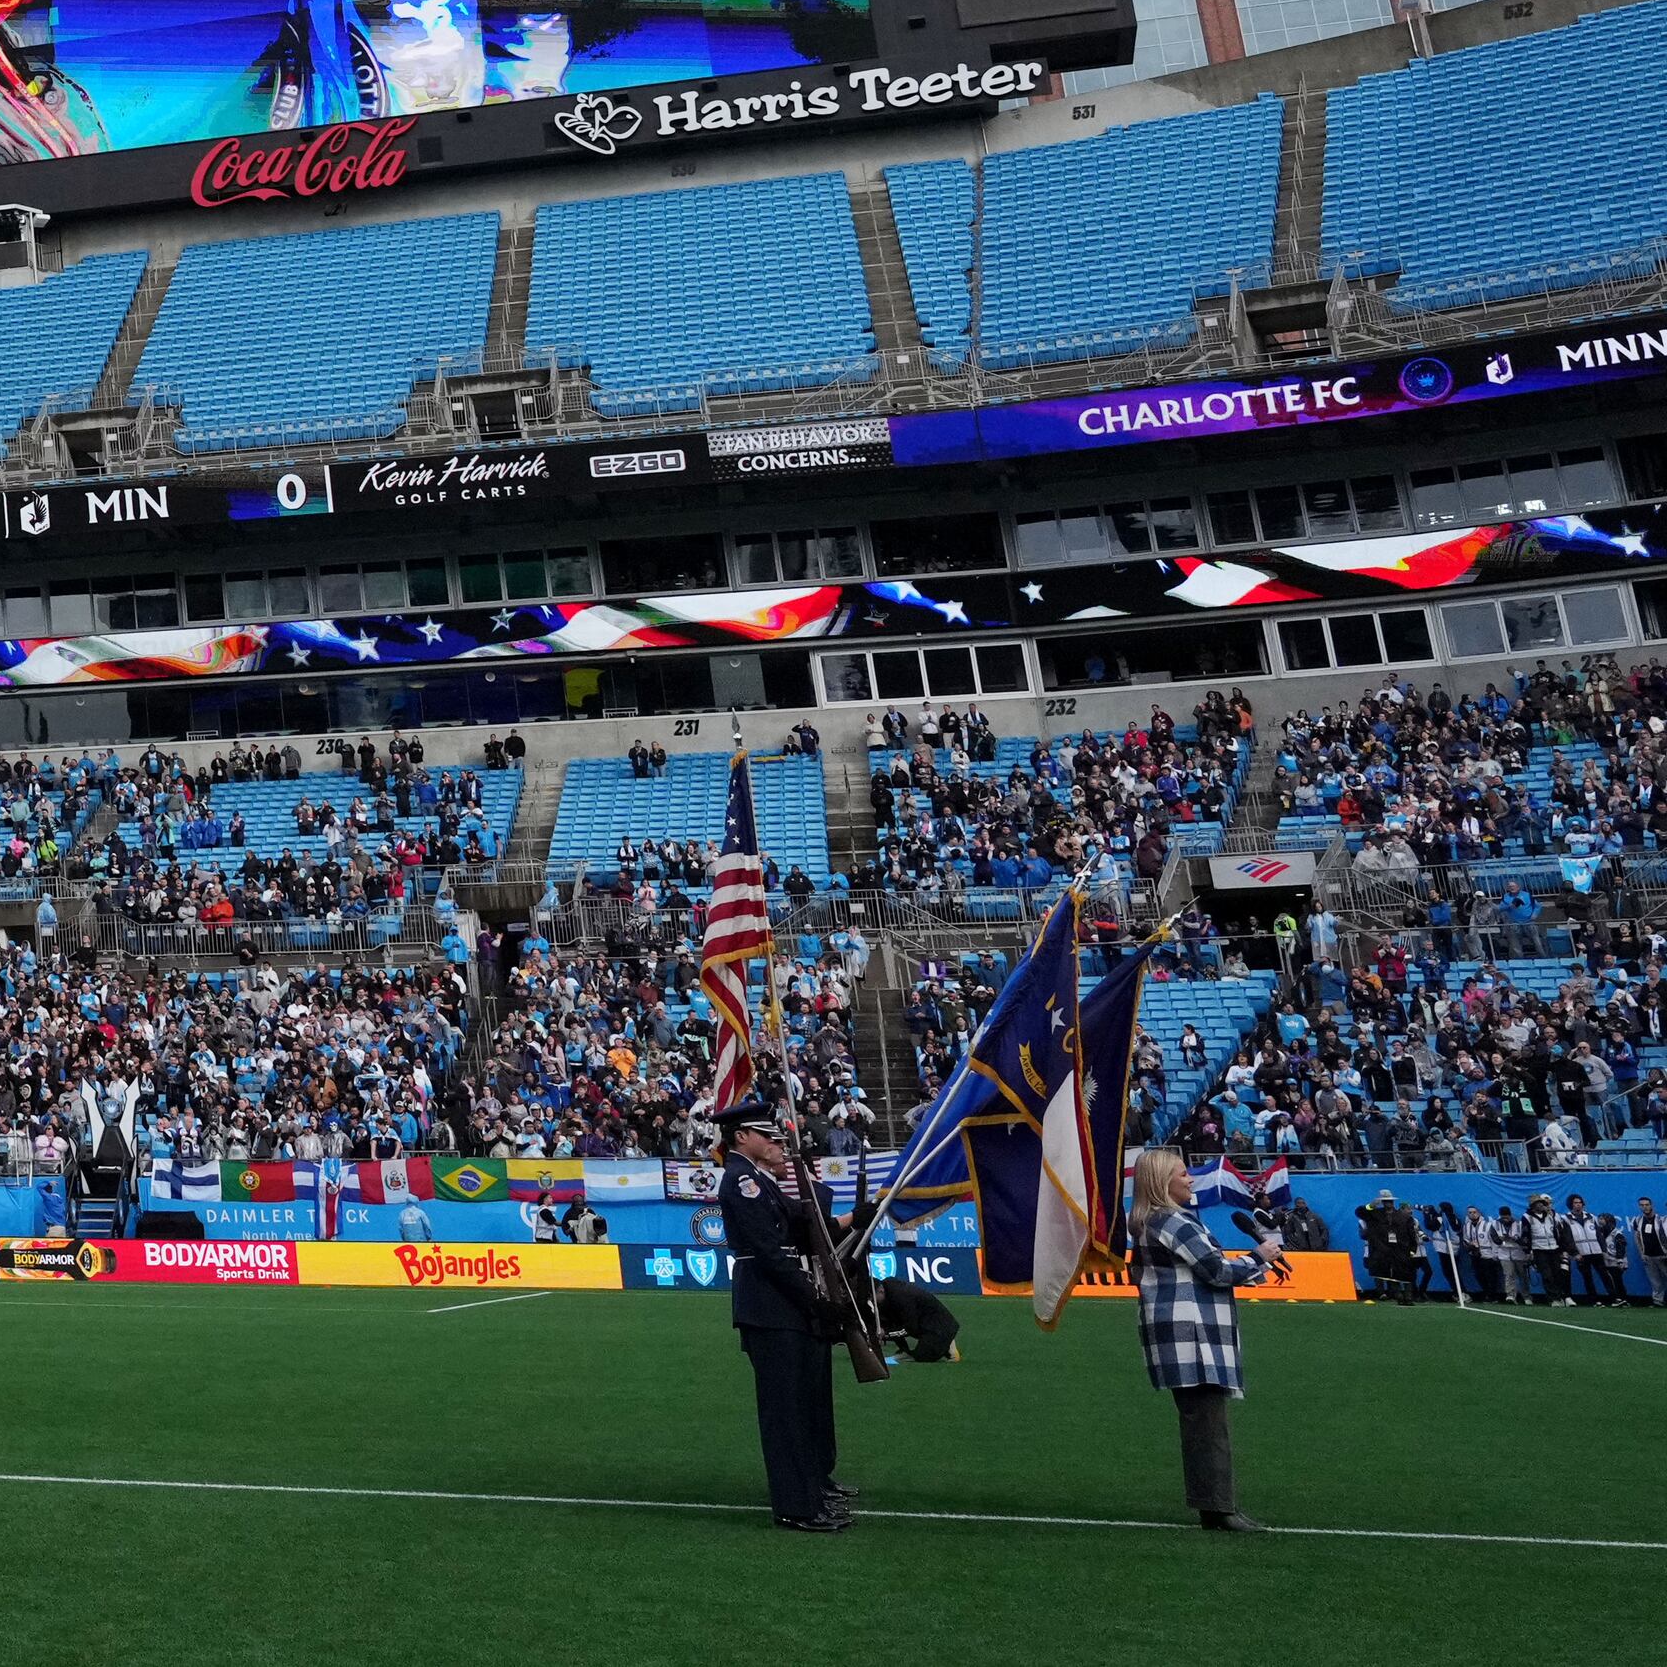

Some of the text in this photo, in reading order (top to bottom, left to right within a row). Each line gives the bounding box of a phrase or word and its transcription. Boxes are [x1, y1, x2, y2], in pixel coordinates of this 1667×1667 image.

[1503, 1, 1535, 20] 532
[651, 58, 1044, 136] Harris Teeter
[1072, 104, 1096, 120] 531
[190, 114, 420, 208] Coca-Cola
[1078, 376, 1360, 435] CHARLOTTE FC
[725, 426, 874, 453] FAN BEHAVIOR
[593, 452, 683, 475] EZGO
[358, 460, 434, 493] Kevin
[276, 473, 307, 510] 0
[395, 484, 526, 505] GOLF CARTS
[84, 485, 170, 525] MIN
[1045, 697, 1077, 717] 232
[674, 719, 700, 736] 231
[206, 1208, 370, 1223] DAIMLER TCK
[243, 1229, 278, 1241] North
[14, 1253, 75, 1265] BODYARMOR
[144, 1242, 289, 1268] BODYARMOR
[393, 1244, 521, 1286] Bojangles
[216, 1268, 290, 1281] Sports Drink
[905, 1256, 954, 1284] NC
